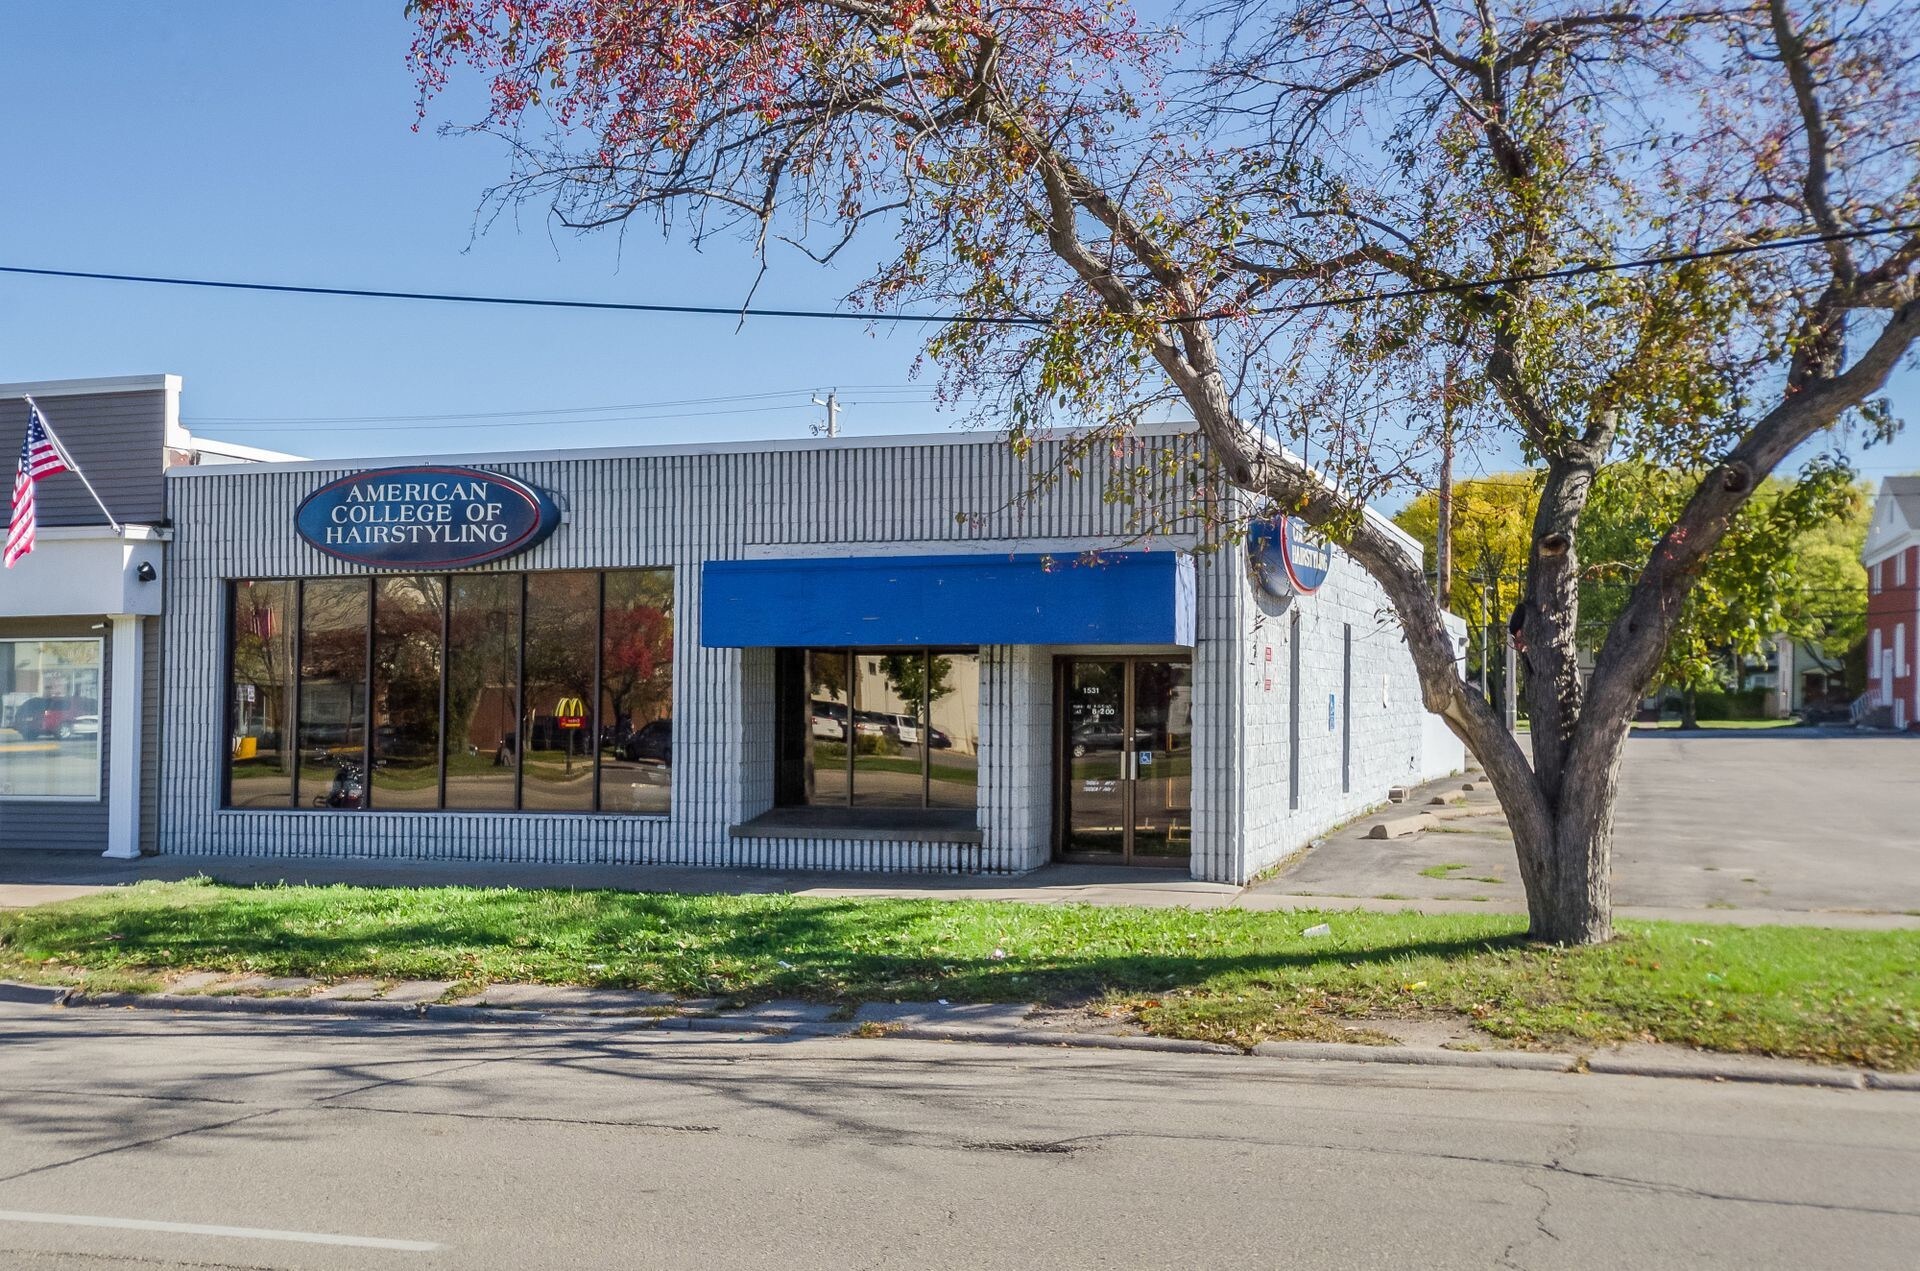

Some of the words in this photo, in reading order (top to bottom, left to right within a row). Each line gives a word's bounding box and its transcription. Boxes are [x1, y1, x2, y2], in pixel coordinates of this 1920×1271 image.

[346, 482, 489, 503] AMERICAN
[331, 504, 451, 524] COLLEGE
[466, 503, 502, 522] OF
[325, 524, 508, 544] HAIRSTYLING
